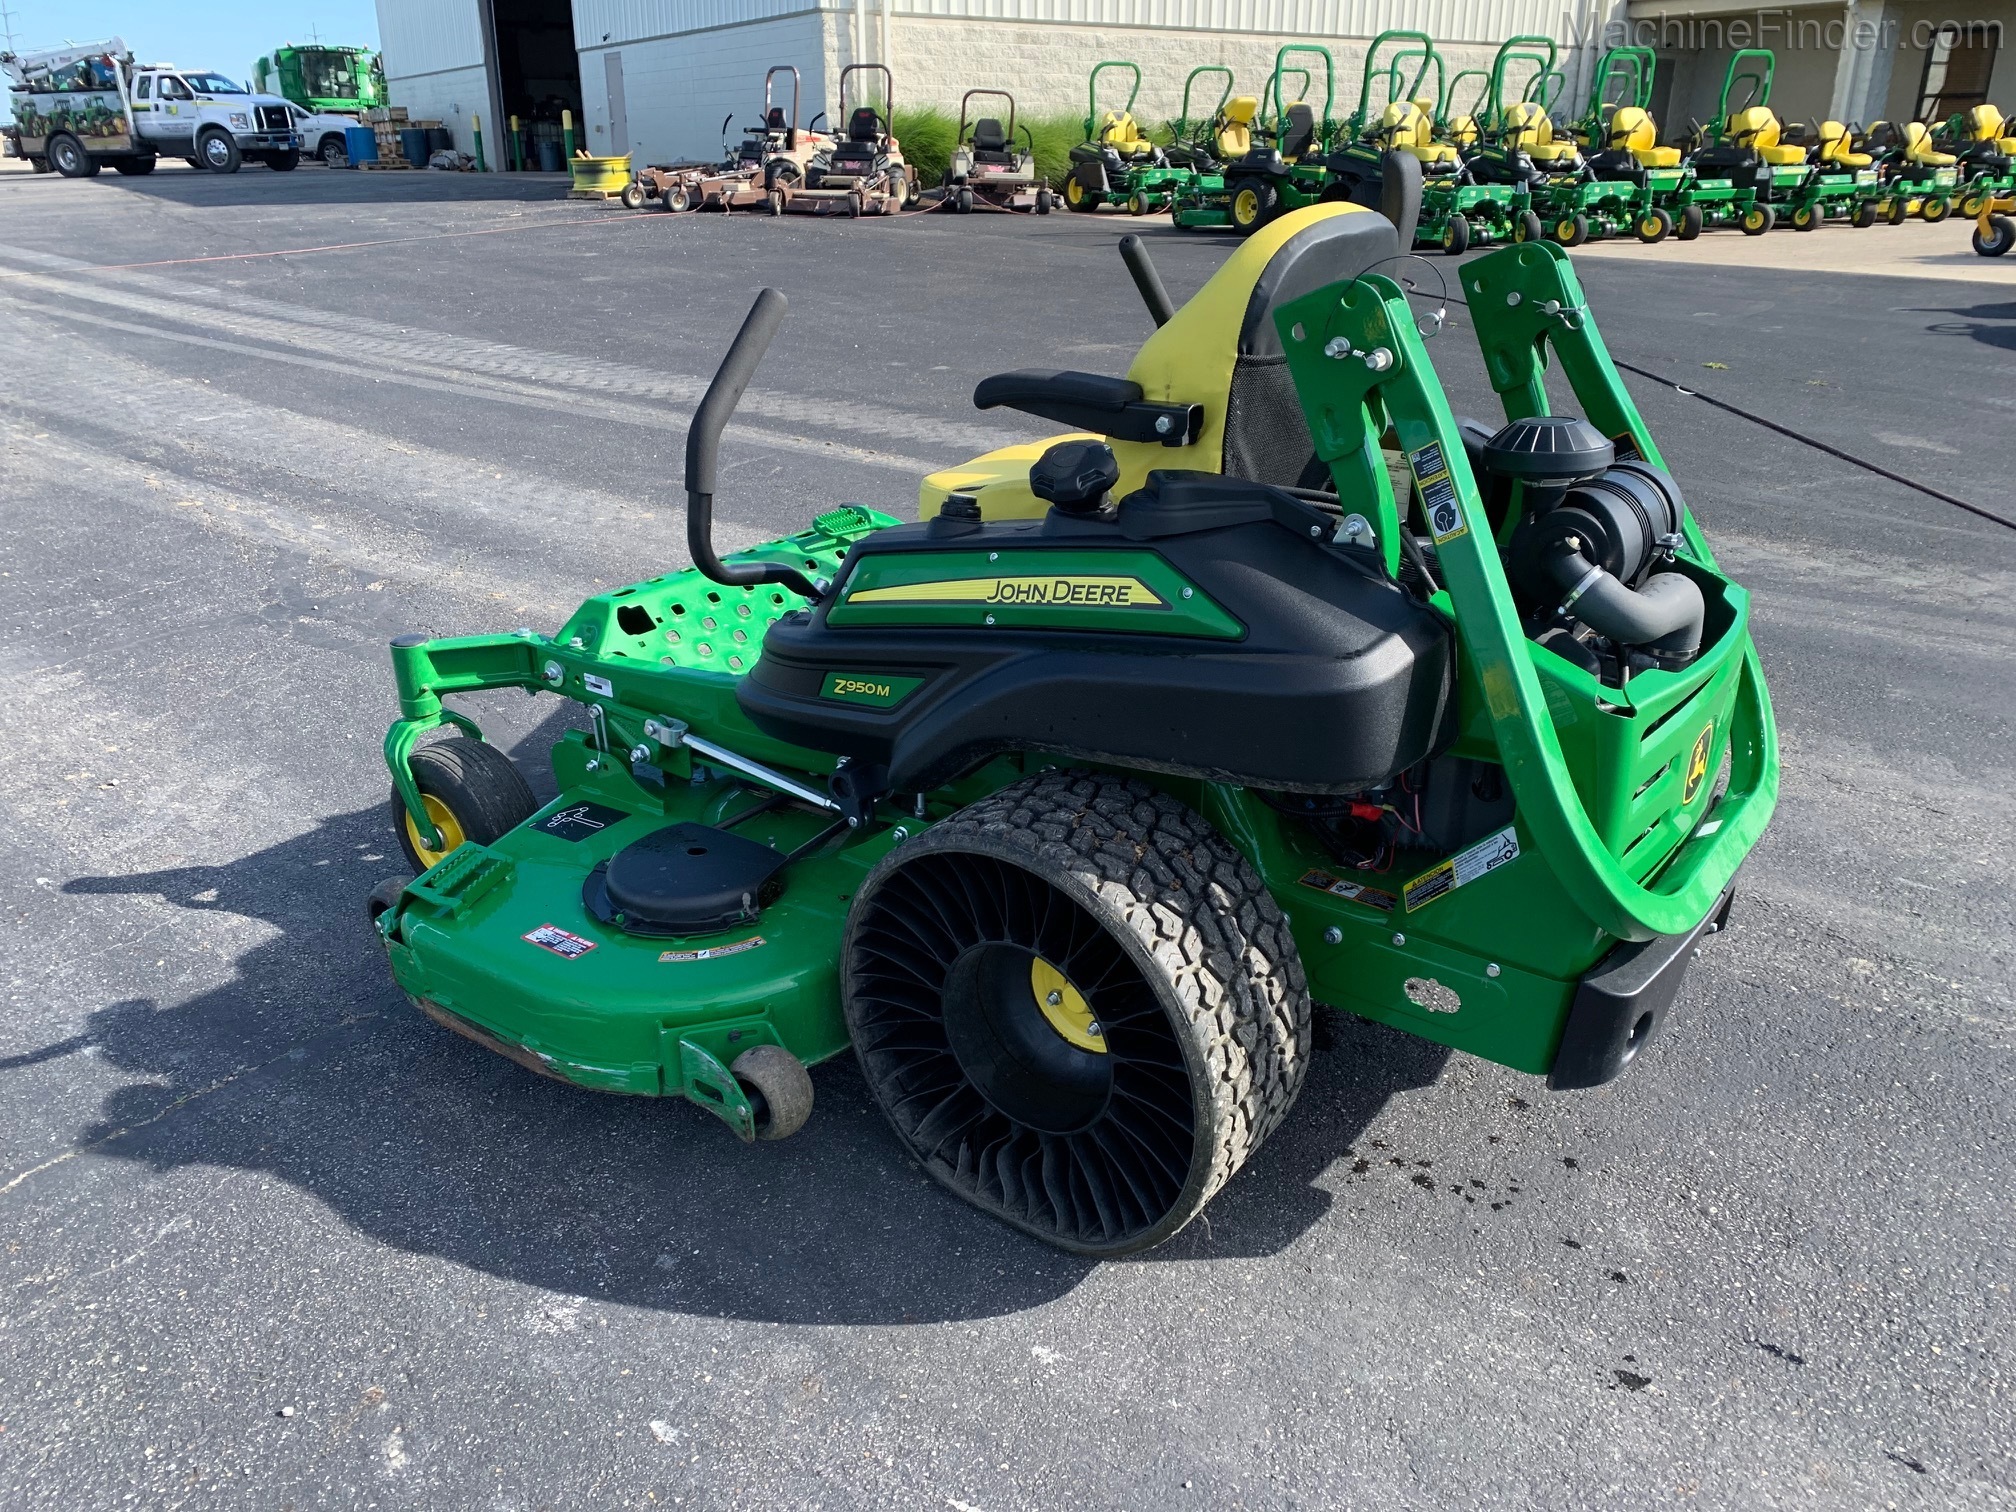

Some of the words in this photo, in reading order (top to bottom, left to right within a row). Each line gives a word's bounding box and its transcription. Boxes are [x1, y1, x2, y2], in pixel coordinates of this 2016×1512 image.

[1439, 530, 1461, 543] CAUTION
[987, 581, 1048, 601] JOHN
[1052, 581, 1132, 603] DEERE
[833, 679, 890, 697] Z950M
